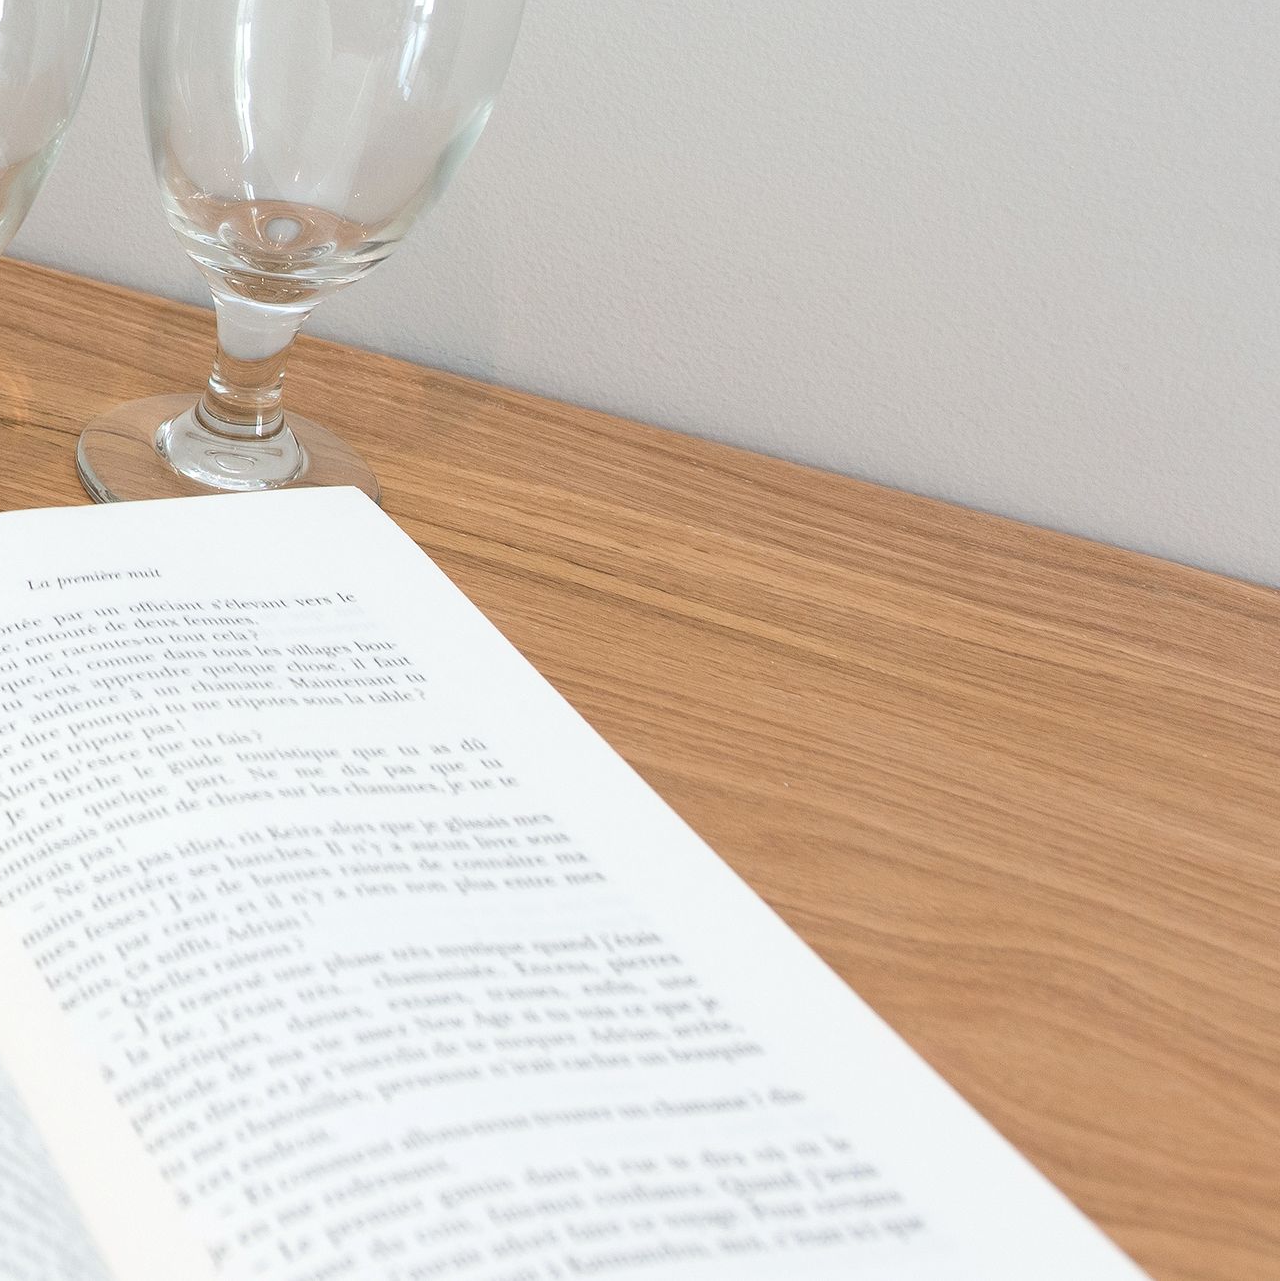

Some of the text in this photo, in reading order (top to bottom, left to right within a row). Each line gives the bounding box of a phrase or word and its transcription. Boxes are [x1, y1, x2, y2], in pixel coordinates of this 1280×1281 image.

[53, 611, 82, 627] par
[94, 607, 119, 617] un
[295, 596, 332, 606] vers
[337, 592, 354, 603] le
[24, 623, 96, 647] entouré
[105, 620, 126, 632] de
[134, 618, 179, 628] deux
